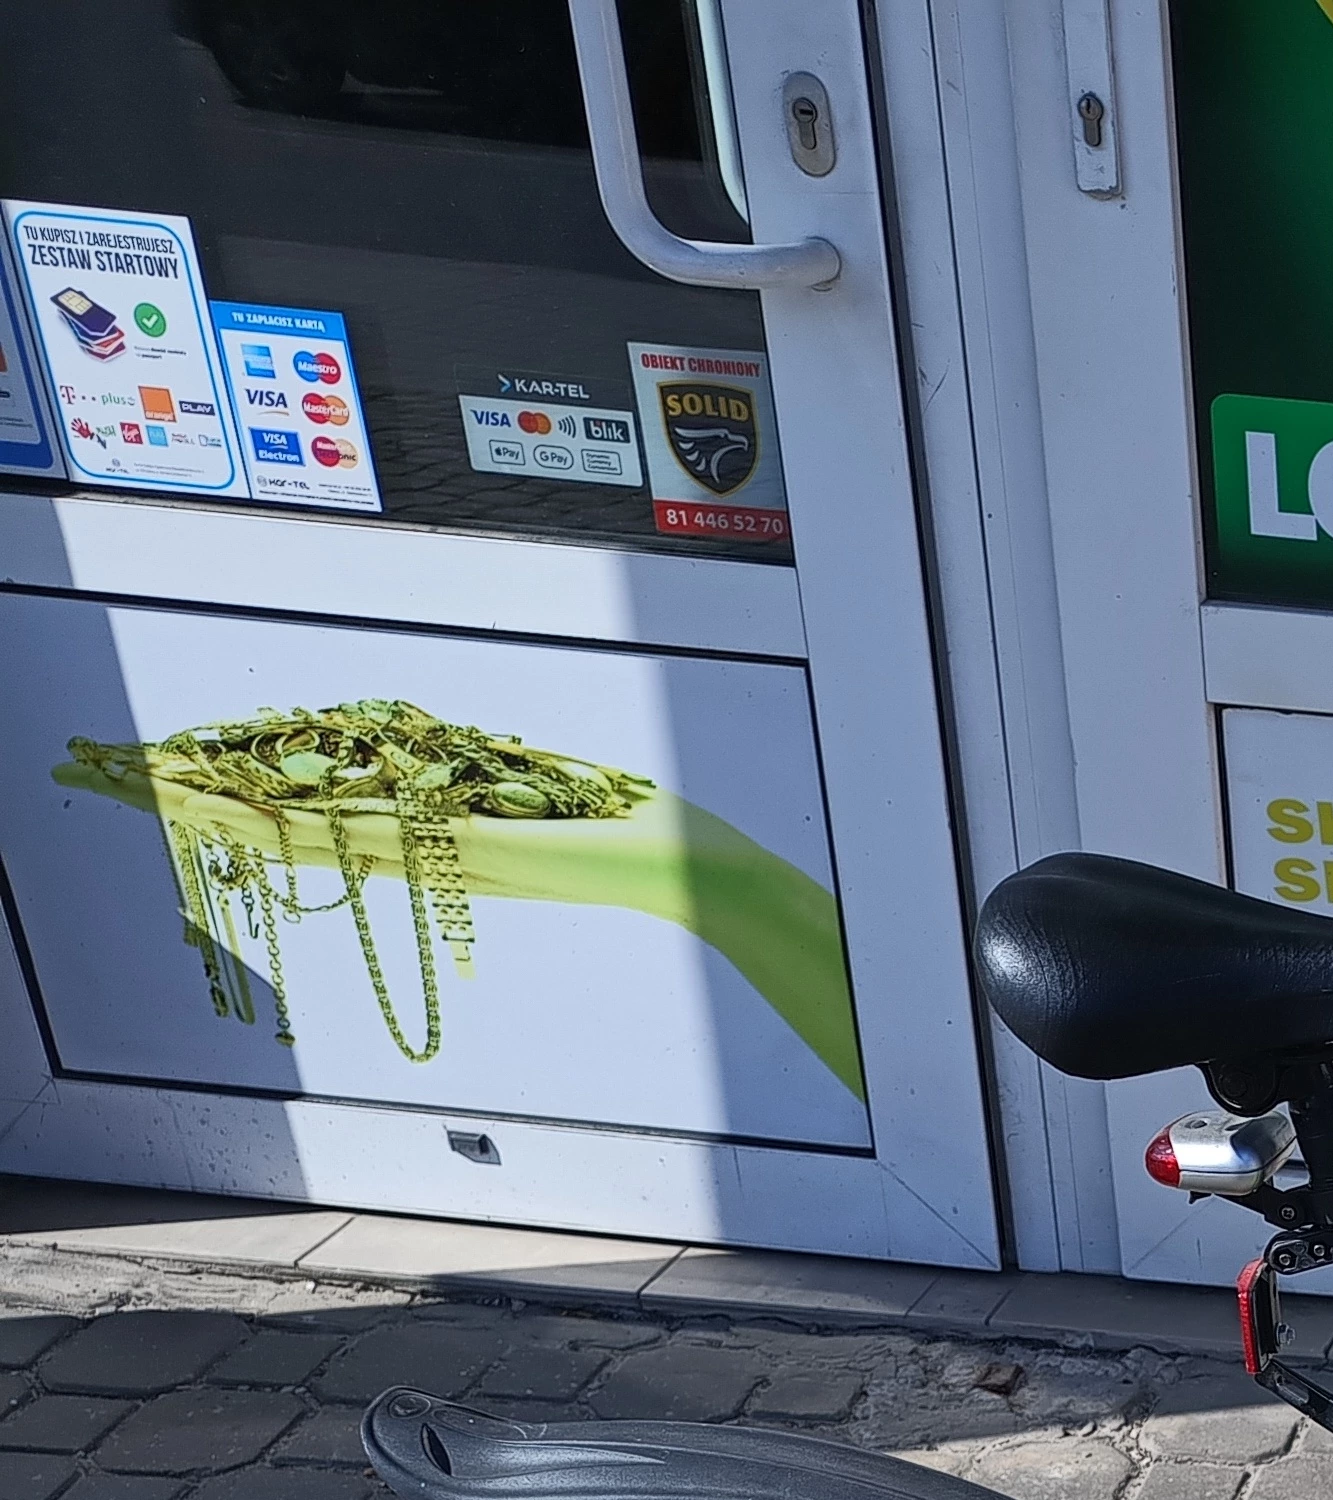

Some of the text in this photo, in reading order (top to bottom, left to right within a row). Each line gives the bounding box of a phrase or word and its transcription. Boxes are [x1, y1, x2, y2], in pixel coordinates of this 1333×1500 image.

[23, 225, 38, 241] TU
[39, 226, 78, 245] KUPISZ
[85, 231, 175, 254] ZAREJESTRUJESZ
[28, 244, 179, 280] ZESTAW STARTOWY
[232, 311, 245, 323] TU
[297, 361, 338, 375] Maestro
[641, 353, 761, 378] OBIEKT CHRONIONY
[515, 378, 590, 399] KAR-TEL
[101, 392, 126, 406] plus
[245, 389, 288, 408] VISA
[666, 392, 750, 423] SOLID
[181, 403, 212, 414] PLAY
[470, 409, 512, 427] VISA
[262, 432, 287, 445] VISA
[590, 419, 624, 441] blik
[258, 450, 299, 462] Electron
[666, 508, 784, 535] 81 446 52 70
